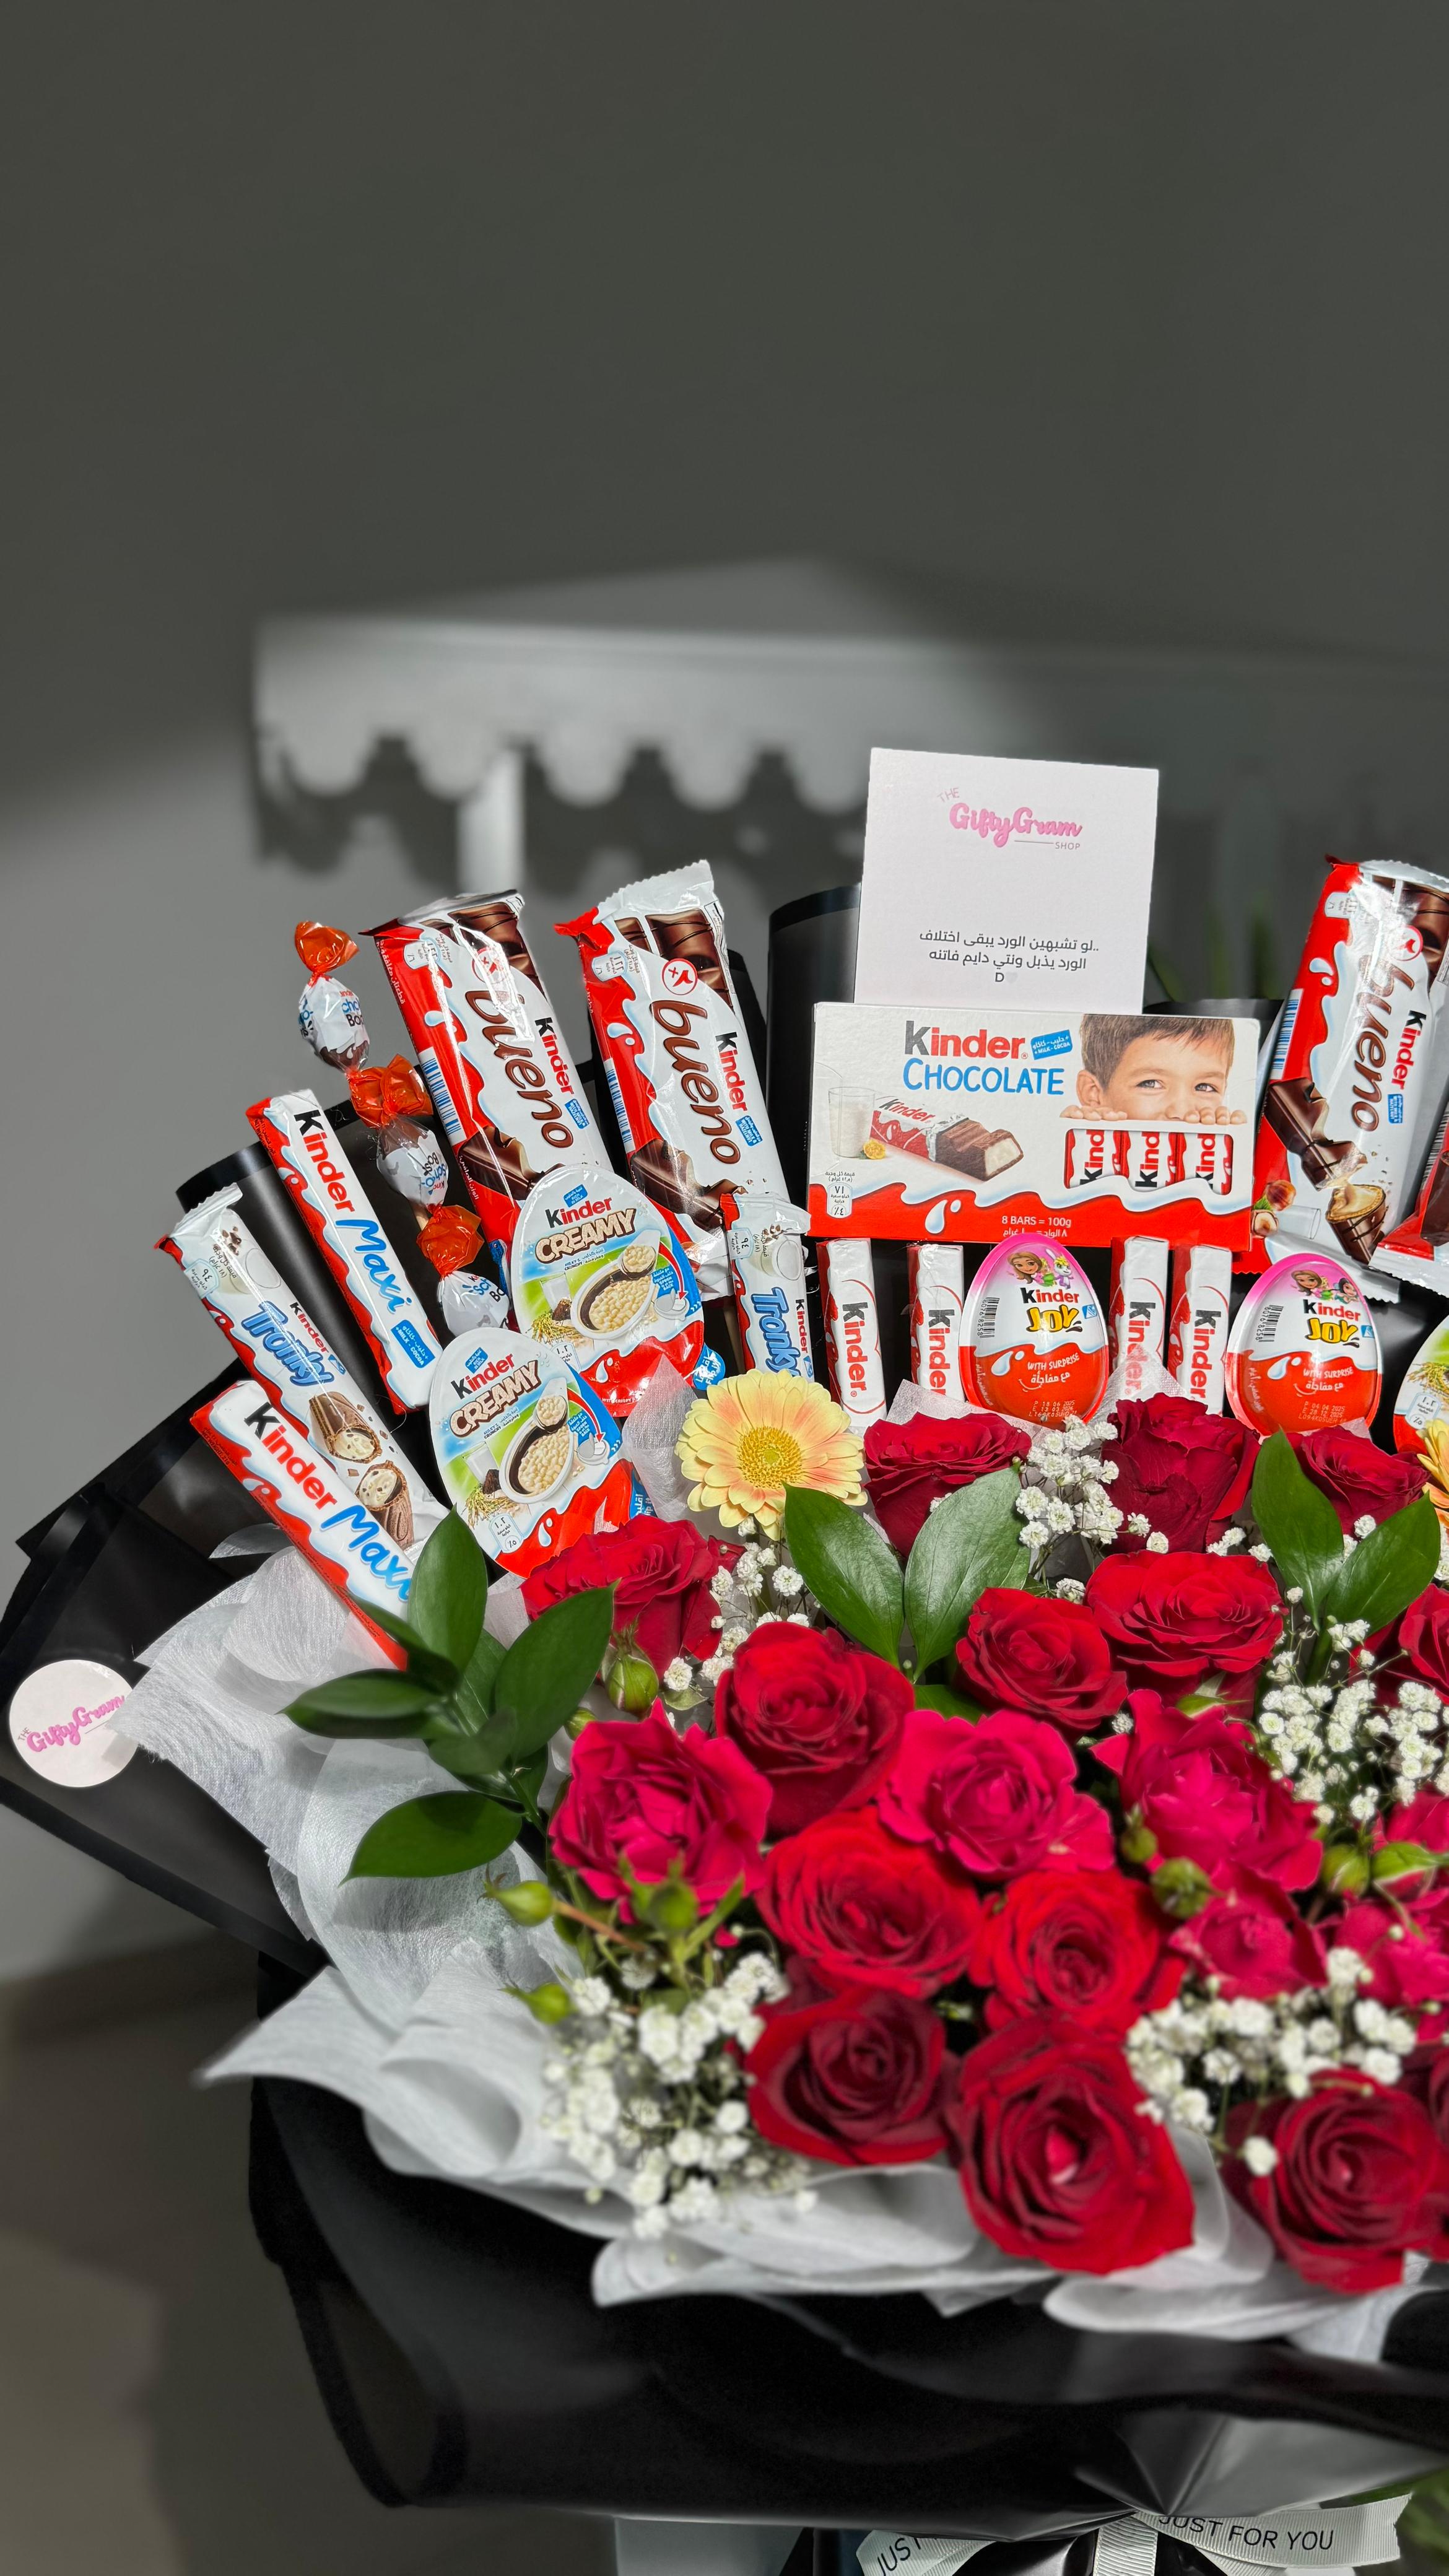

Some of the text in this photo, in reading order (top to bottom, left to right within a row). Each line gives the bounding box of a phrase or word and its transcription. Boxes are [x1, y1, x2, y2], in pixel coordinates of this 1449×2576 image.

[937, 787, 960, 803] THE
[1055, 842, 1081, 850] SHOP
[920, 929, 960, 942] اختلاف
[964, 933, 994, 947] يبقى
[997, 936, 1025, 949] الورد
[1029, 937, 1077, 952] تشبهين
[612, 955, 625, 972] ١٢٢
[929, 949, 1087, 971] الورد يذبل ونتي دايم فاتنه
[994, 972, 1004, 982] D
[904, 1020, 1025, 1060] Kinder
[1351, 955, 1415, 1131] bueno
[1391, 1010, 1427, 1090] Kinder
[535, 1017, 575, 1095] Kinder
[465, 990, 574, 1148] bueno
[715, 1032, 748, 1112] Kinder
[903, 1057, 1065, 1095] CHOCOLATE
[650, 1000, 741, 1164] bueno
[879, 1099, 936, 1121] Kinder
[468, 1182, 479, 1200] الوزن
[294, 1110, 412, 1313] Kinder Maxi
[545, 1196, 612, 1229] Kinder
[1001, 1216, 1007, 1224] 8
[1010, 1216, 1037, 1225] BARS
[1048, 1217, 1071, 1229] 100g
[534, 1208, 637, 1264] CREAMY
[740, 1237, 749, 1248] ٩٤
[199, 1268, 214, 1283] ٩٤
[1020, 1287, 1080, 1303] Kinder
[1025, 1304, 1080, 1333] JOY
[1303, 1299, 1360, 1321] Kinder
[290, 1302, 329, 1353] Kinder
[751, 1287, 801, 1377] Tronky
[795, 1299, 808, 1354] Kinder
[1304, 1318, 1359, 1344] JOY
[241, 1300, 334, 1386] Tronky
[842, 1302, 868, 1392] Kinder
[1125, 1302, 1156, 1390] Kinder
[1190, 1310, 1222, 1399] Kinder
[409, 1346, 425, 1366] COCOA
[1027, 1352, 1080, 1370] WITH SURPRISE
[451, 1353, 515, 1399] Kinder
[1030, 1370, 1071, 1385] مع مفاجأة
[1303, 1367, 1354, 1378] WITH SURPRISE
[450, 1360, 542, 1437] CREAMY
[1334, 1382, 1344, 1392] مع
[1422, 1397, 1436, 1406] ١٠٢
[245, 1402, 337, 1510] Kinder
[494, 1516, 505, 1528] ١٠٢
[17, 1726, 32, 1741] THE
[1229, 2525, 1277, 2549] FOR
[1287, 2530, 1334, 2551] YOU
